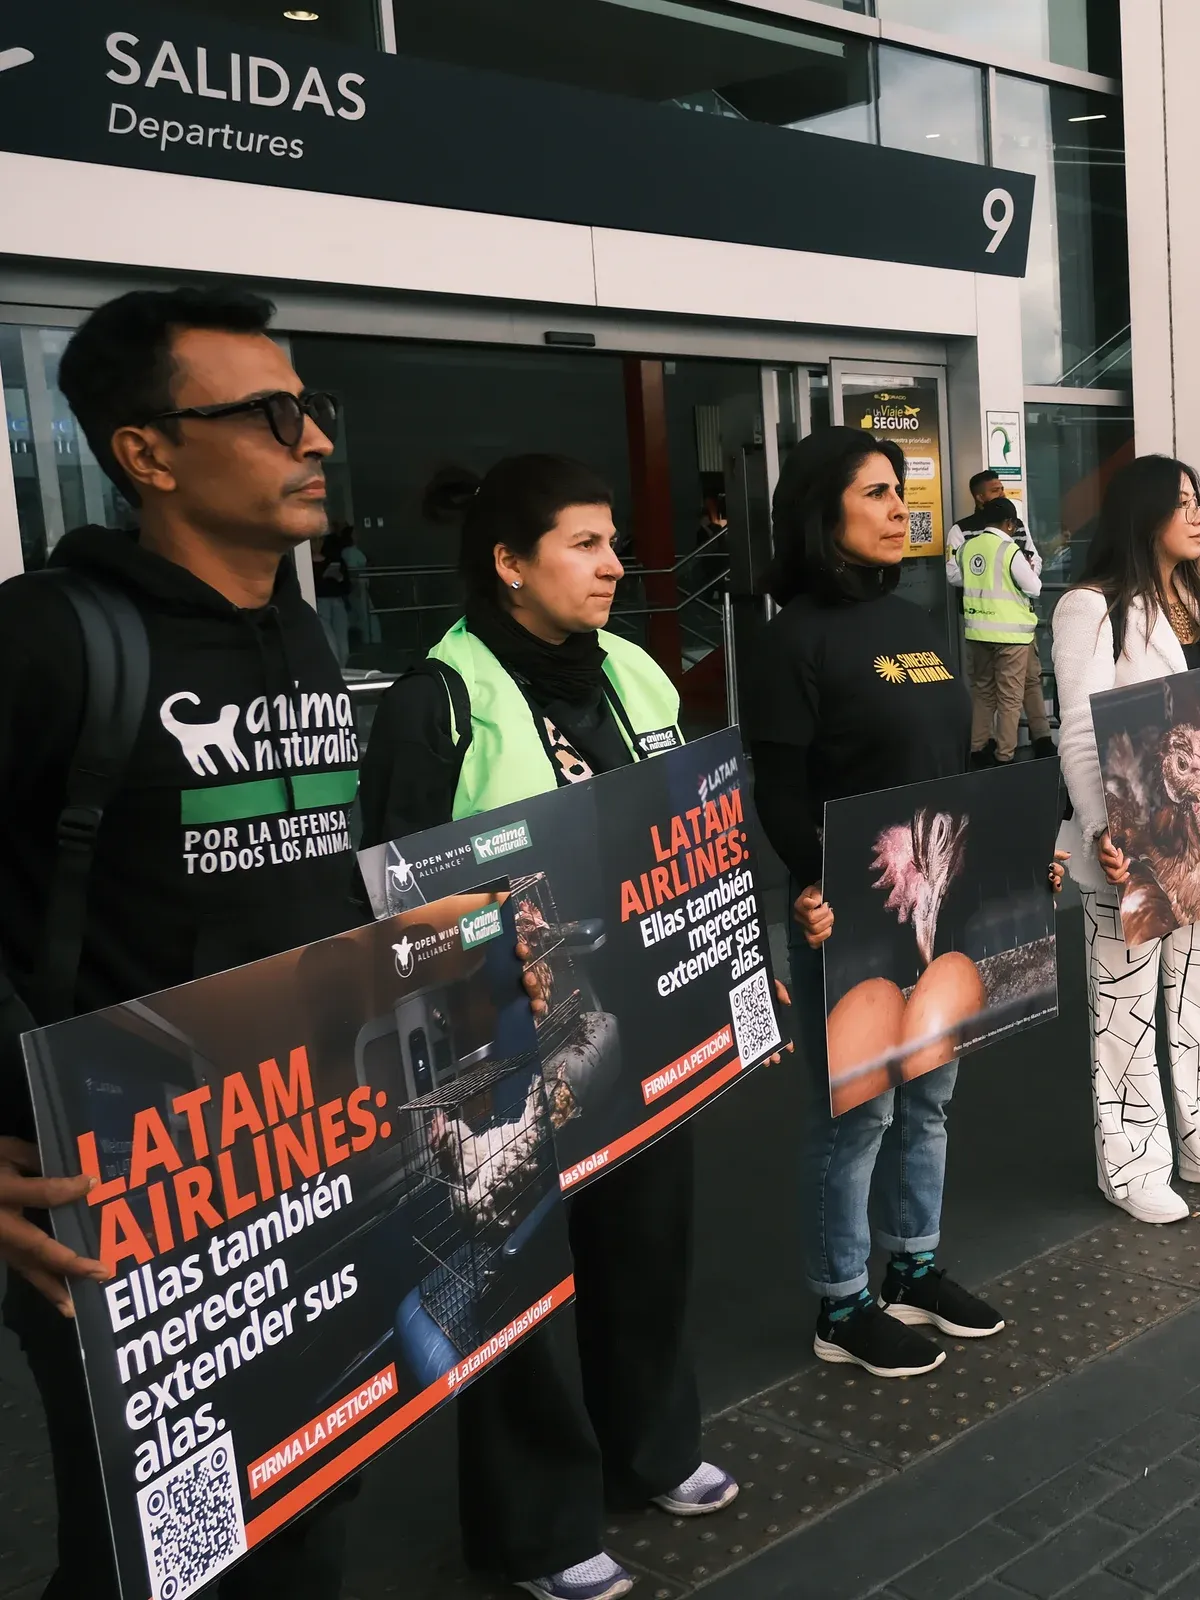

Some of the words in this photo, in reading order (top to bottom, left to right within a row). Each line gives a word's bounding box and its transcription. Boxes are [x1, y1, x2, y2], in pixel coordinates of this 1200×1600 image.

[105, 31, 366, 121] SALIDAS
[108, 103, 304, 159] Departures
[982, 188, 1014, 254] 9
[873, 416, 919, 430] SEGURO
[880, 404, 903, 419] Viaje
[896, 651, 943, 669] SINERGIA
[906, 665, 954, 684] ANIMAL
[246, 680, 353, 734] anima
[646, 730, 673, 744] anima
[649, 738, 677, 751] naturalis
[707, 756, 738, 791] LATAM
[184, 827, 239, 851] POR
[249, 821, 272, 845] LA
[278, 810, 347, 840] DEFENSA
[492, 826, 525, 845] anima
[493, 835, 528, 855] naturalis
[650, 787, 744, 863] LATAM
[183, 846, 265, 874] TODOS
[270, 840, 302, 865] LOS
[415, 854, 442, 869] OPEN
[445, 844, 472, 859] WING
[621, 829, 749, 923] AIRLINES:
[474, 909, 498, 929] anima
[475, 921, 501, 941] naturalis
[639, 907, 686, 948] Ellas
[685, 868, 753, 923] también
[688, 895, 757, 952] merecen
[414, 937, 437, 951] OPEN
[438, 925, 460, 938] WING
[657, 933, 733, 998] extender
[735, 918, 760, 950] sus
[730, 945, 763, 980] alas.
[643, 1068, 678, 1099] FIRMA
[677, 1059, 691, 1078] LA
[690, 1030, 731, 1072] PETICIÓN
[76, 1045, 316, 1207] LATAM
[98, 1085, 393, 1282] AIRLINES:
[105, 1254, 204, 1333] Ellas
[207, 1172, 353, 1277] también
[116, 1258, 289, 1384] merecen
[125, 1298, 297, 1431] extender
[303, 1263, 359, 1322] sus
[447, 1295, 553, 1389] #LatamDéjalasVolar
[134, 1402, 227, 1483] alas.
[251, 1439, 304, 1490] FIRMA
[304, 1422, 326, 1450] LA
[326, 1372, 393, 1435] PETICIÓN
